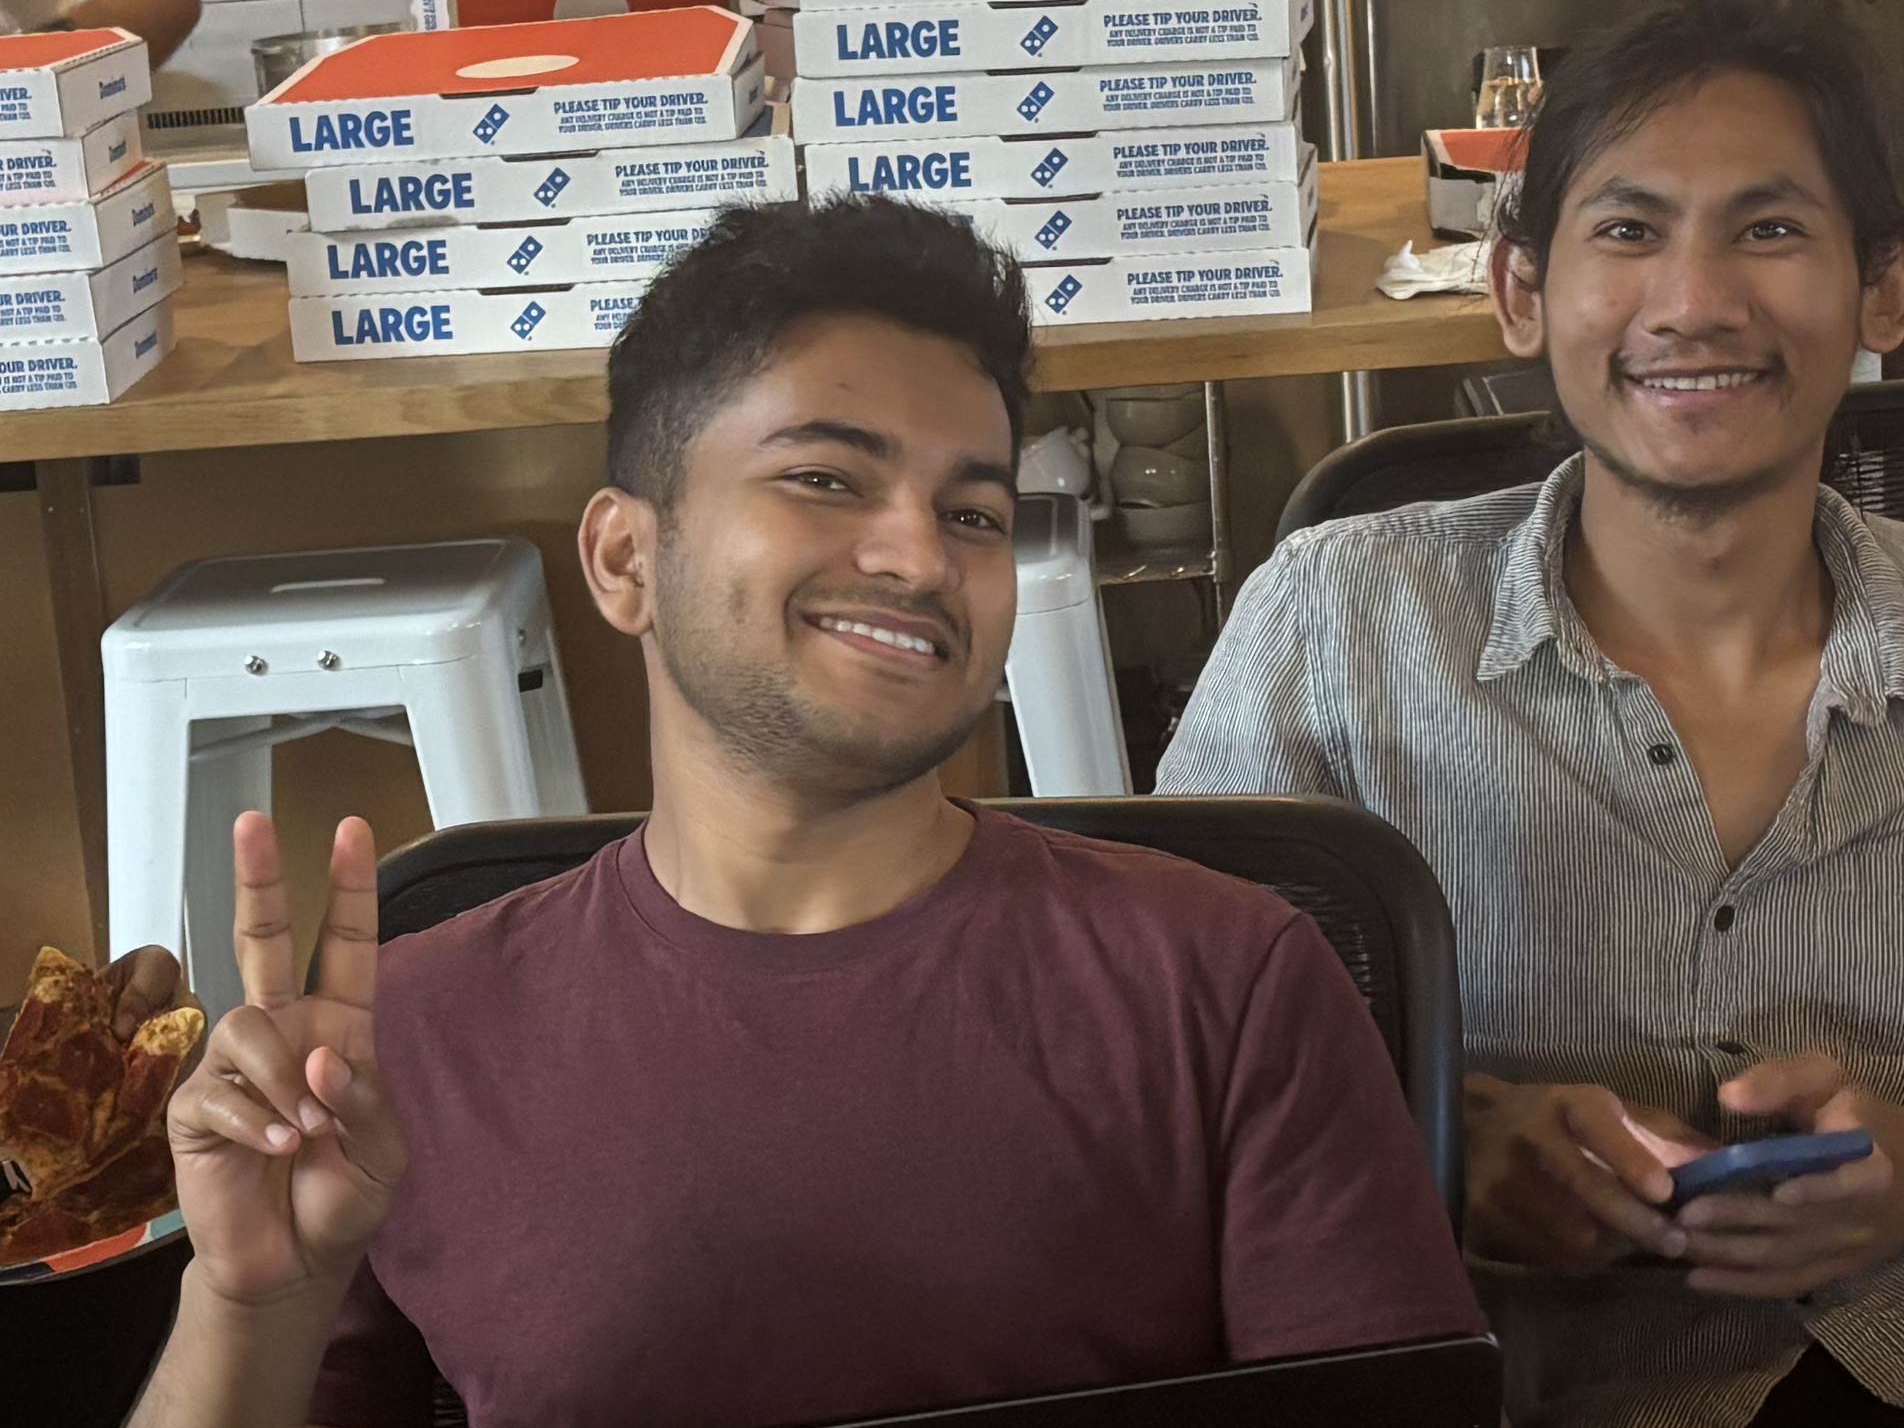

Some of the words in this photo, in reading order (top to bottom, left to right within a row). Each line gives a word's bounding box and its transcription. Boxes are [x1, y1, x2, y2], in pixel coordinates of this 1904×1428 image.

[1104, 13, 1150, 27] PLEASE
[1153, 12, 1172, 25] TIP
[1176, 11, 1209, 24] YOUR
[837, 21, 961, 61] LARGE
[1100, 78, 1145, 92] PLEASE
[1149, 76, 1167, 89] TIP
[1171, 74, 1204, 88] YOUR
[554, 99, 598, 114] PLEASE
[602, 98, 620, 111] TIP
[624, 95, 657, 109] YOUR
[833, 85, 958, 128] LARGE
[290, 110, 416, 153] LARGE
[1113, 144, 1158, 159] PLEASE
[1162, 143, 1181, 156] TIP
[1184, 141, 1217, 155] YOUR
[616, 163, 660, 178] PLEASE
[663, 161, 682, 174] TIP
[685, 159, 718, 173] YOUR
[848, 152, 972, 193] LARGE
[350, 173, 473, 214] LARGE
[1117, 206, 1162, 221] PLEASE
[1165, 205, 1184, 218] TIP
[1188, 203, 1220, 216] YOUR
[587, 232, 632, 246] PLEASE
[634, 230, 653, 243] TIP
[655, 228, 689, 242] YOUR
[329, 240, 449, 279] LARGE
[1128, 271, 1172, 285] PLEASE
[1176, 270, 1195, 283] TIP
[1199, 268, 1231, 282] YOUR
[590, 297, 634, 312] PLEASE
[334, 305, 454, 343] LARGE
